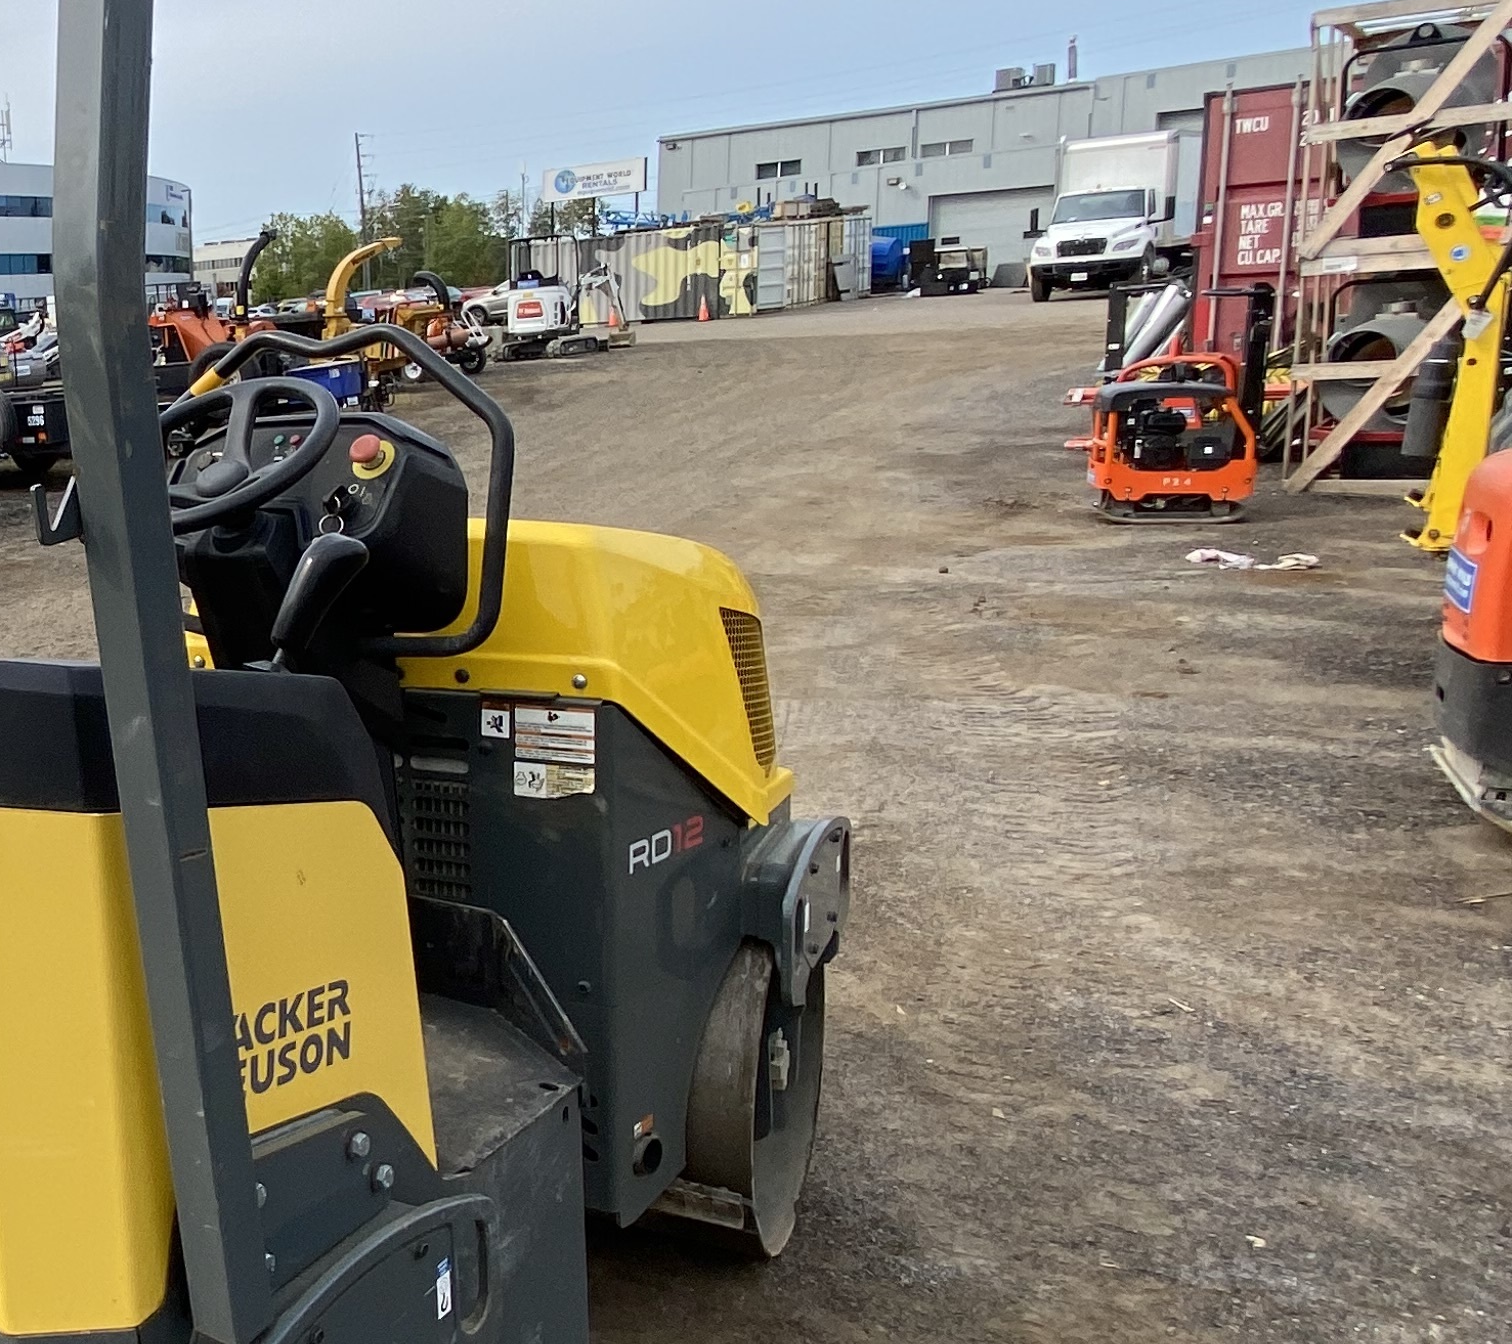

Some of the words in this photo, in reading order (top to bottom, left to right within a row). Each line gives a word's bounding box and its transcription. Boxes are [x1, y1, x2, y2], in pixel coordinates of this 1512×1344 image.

[1235, 116, 1269, 134] TWCU
[581, 178, 618, 189] RENTALS
[1240, 218, 1272, 235] TARE
[1238, 234, 1261, 251] NET
[629, 815, 704, 875] RD12
[235, 979, 351, 1052] ACKER
